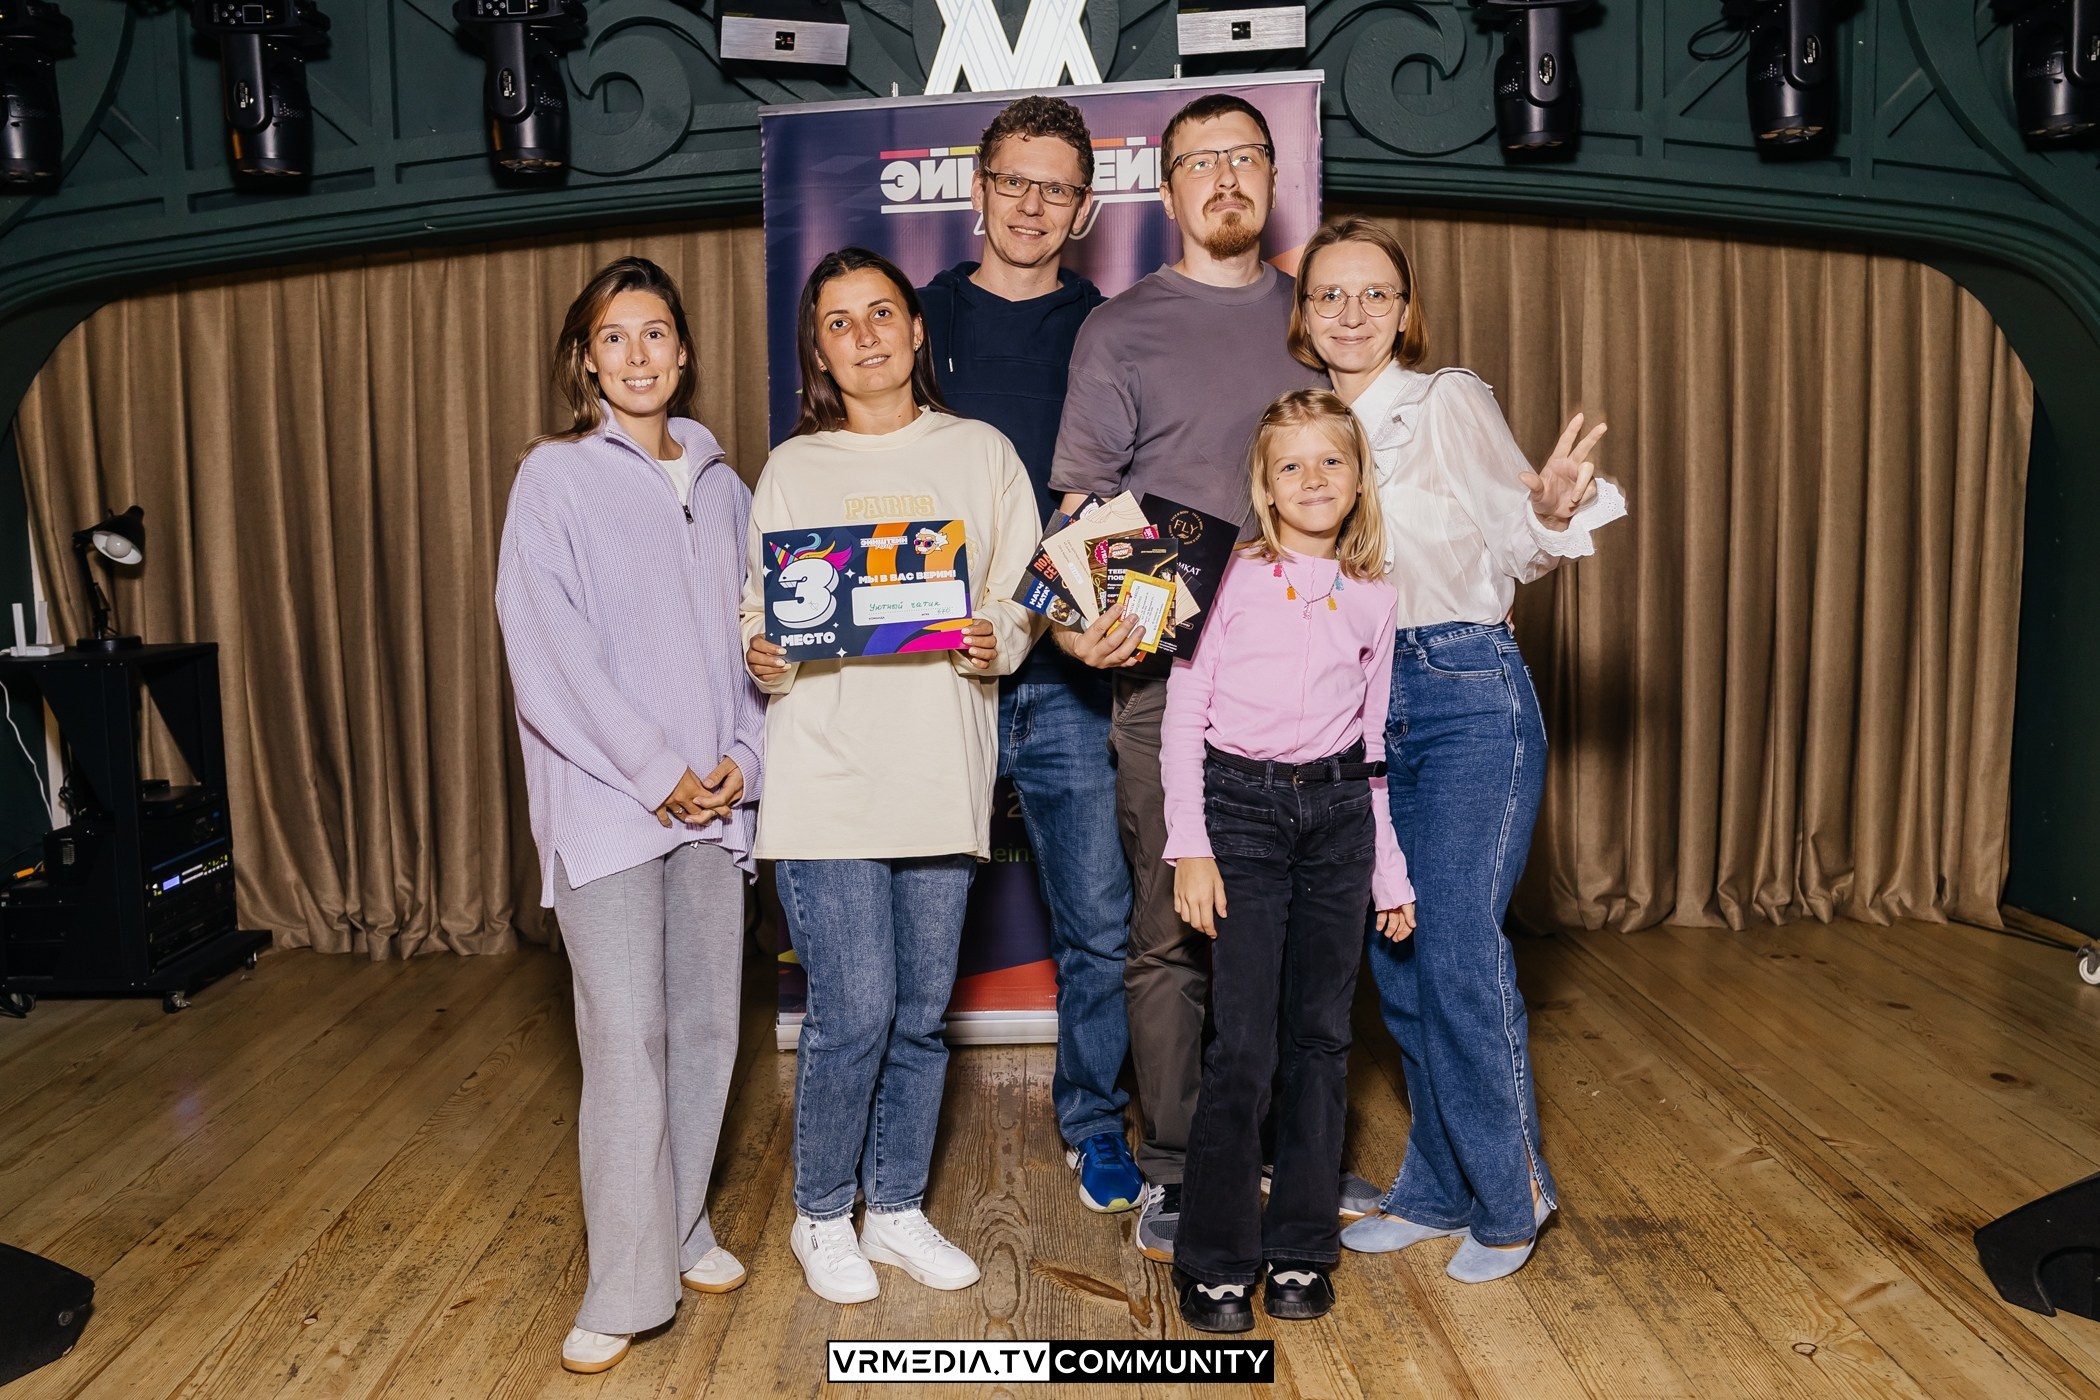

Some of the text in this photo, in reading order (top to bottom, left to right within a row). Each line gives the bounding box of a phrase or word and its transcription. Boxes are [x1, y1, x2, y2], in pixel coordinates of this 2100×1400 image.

[844, 495, 936, 520] PARIS
[1174, 519, 1198, 535] FLY
[858, 569, 956, 585] МЫ В ВАС ВЕРИМ!
[772, 559, 839, 629] 3
[869, 601, 904, 612] Уютный
[780, 631, 836, 647] МЕСТО
